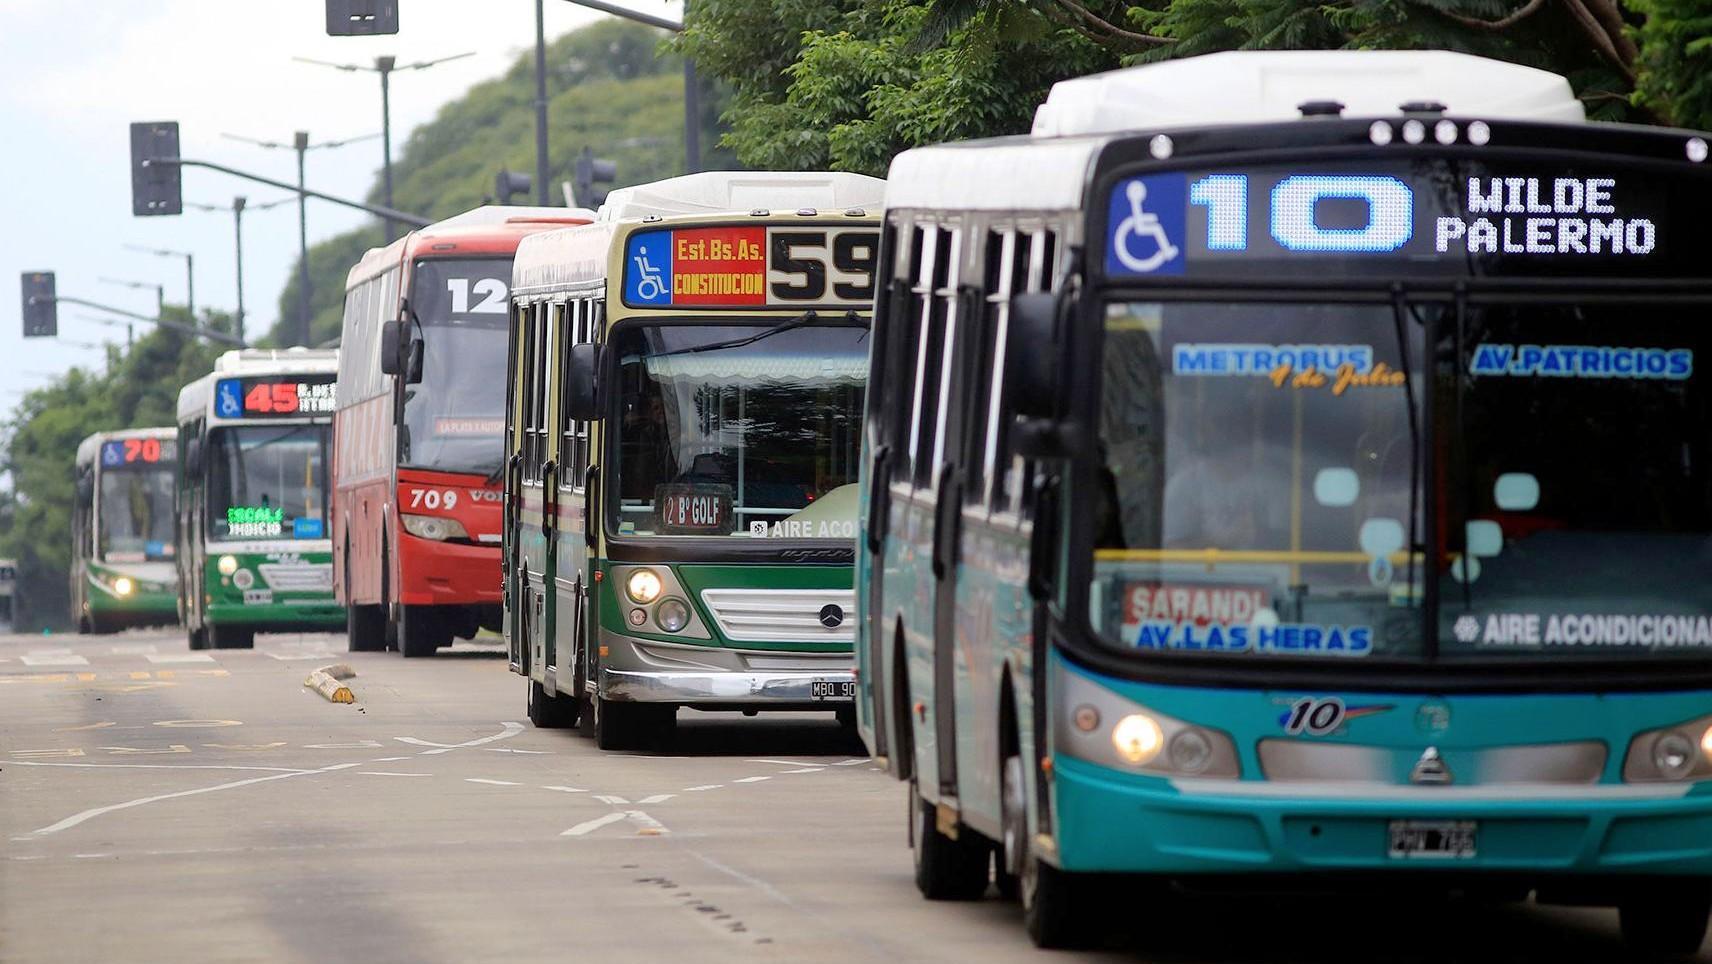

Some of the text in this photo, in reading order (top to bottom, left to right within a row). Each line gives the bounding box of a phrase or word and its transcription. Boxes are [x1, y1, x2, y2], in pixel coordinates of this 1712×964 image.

[1468, 177, 1616, 213] WILDE
[1190, 174, 1413, 251] 10
[1436, 216, 1656, 254] PALERMO
[677, 239, 764, 261] Est.Bs.As.
[770, 231, 881, 301] 59
[447, 278, 508, 314] 12
[673, 273, 763, 296] CONSTITUCION
[1177, 348, 1369, 371] METROBUS
[1474, 347, 1691, 375] AV.PATRICIOS
[245, 383, 299, 412] 45
[124, 438, 160, 463] 70
[411, 489, 458, 510] 709
[692, 496, 719, 525] GOLF
[772, 520, 858, 538] AIRE ACO
[1137, 626, 1370, 650] AV.LAS HERAS
[1483, 614, 1541, 645] AIRE
[1286, 697, 1346, 736] 10
